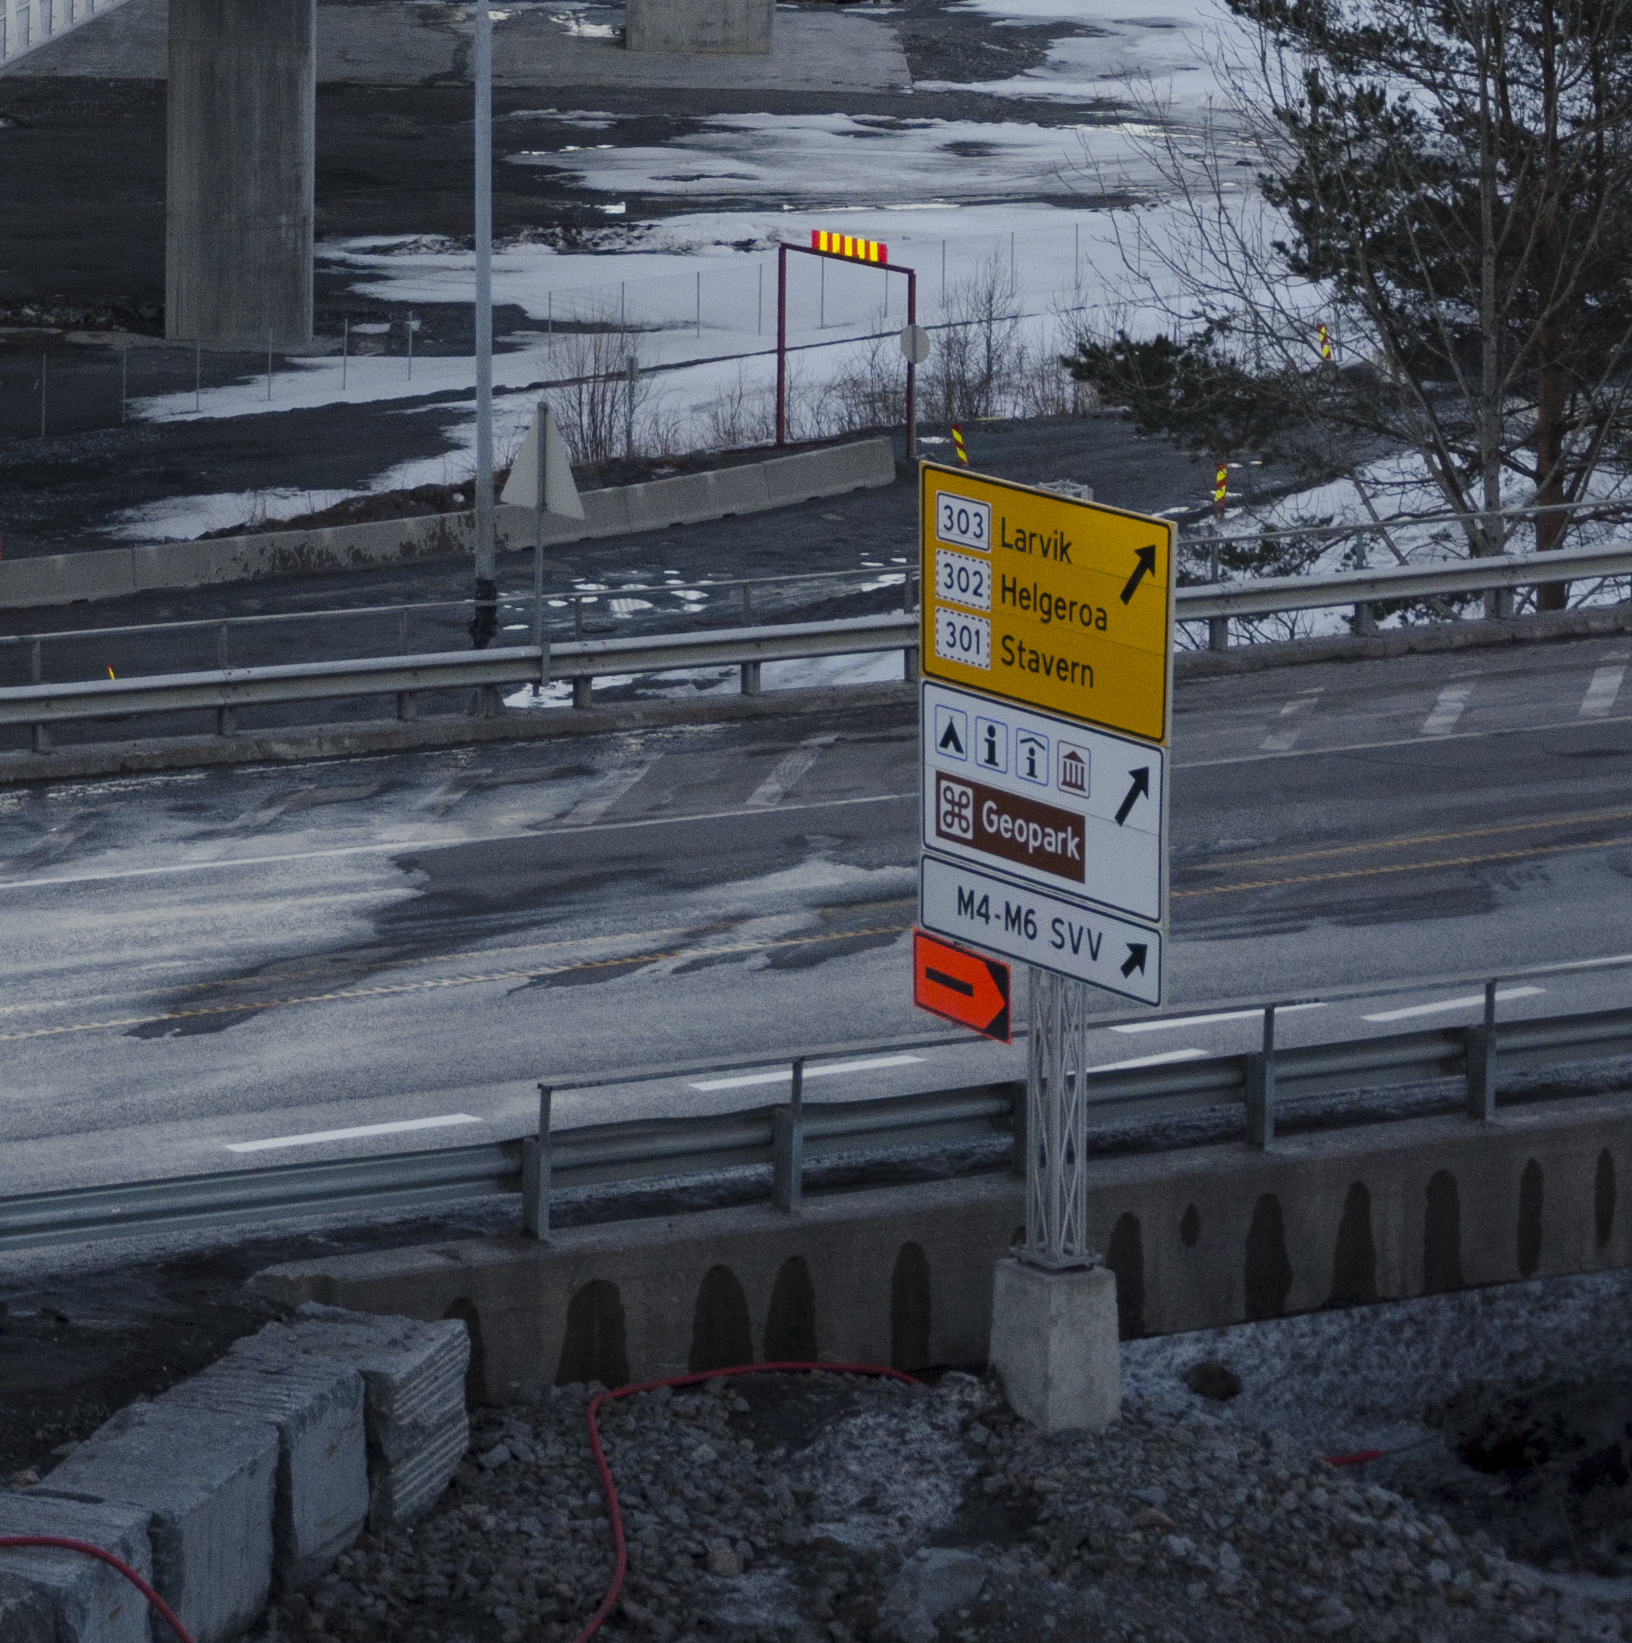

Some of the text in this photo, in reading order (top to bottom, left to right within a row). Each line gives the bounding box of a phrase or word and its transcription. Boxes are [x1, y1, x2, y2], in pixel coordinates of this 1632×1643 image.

[943, 504, 1072, 564] 303 Larvik
[943, 563, 1108, 632] 302 Helgeroa
[945, 621, 1095, 689] 301 Stavern
[982, 800, 1080, 861] Geopark
[958, 885, 1103, 963] M4-M6 SVV
